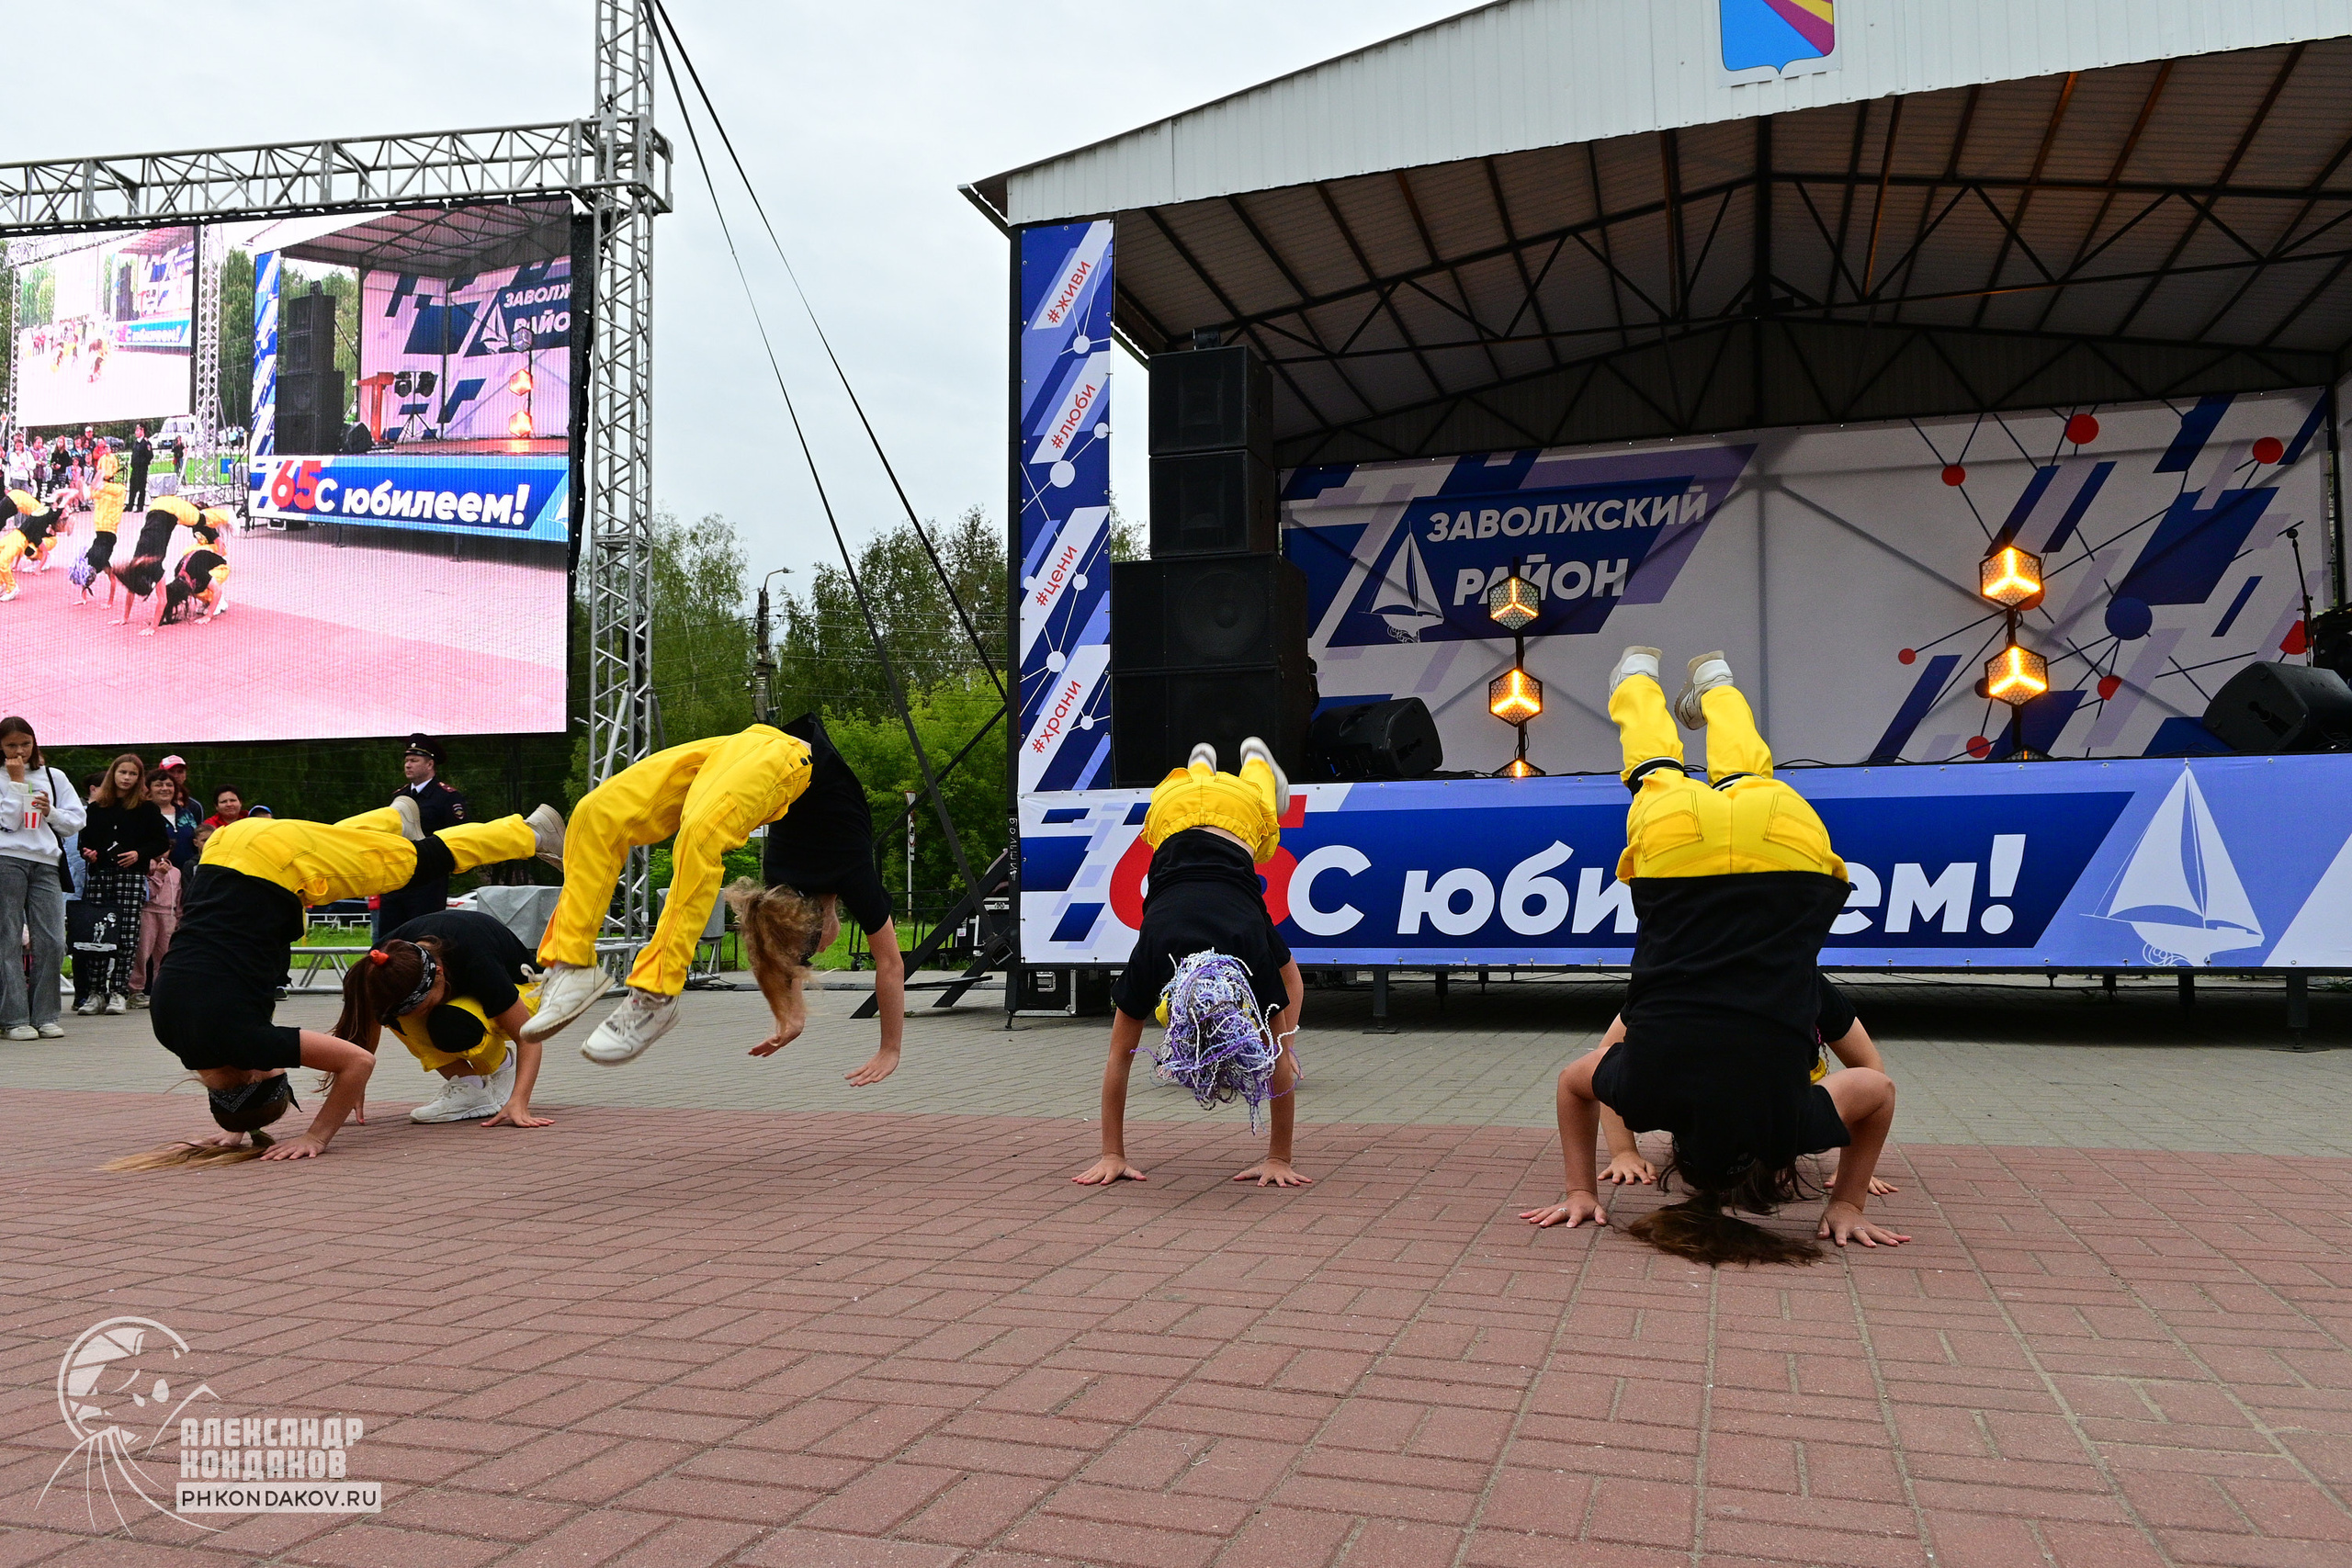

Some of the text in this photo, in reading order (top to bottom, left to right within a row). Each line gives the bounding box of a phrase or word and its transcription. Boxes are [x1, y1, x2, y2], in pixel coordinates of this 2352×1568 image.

[1046, 260, 1091, 323] #живи
[1051, 383, 1096, 449] #люби
[271, 460, 322, 510] 65
[342, 479, 530, 525] юбилеем!
[1426, 485, 1709, 543] ЗАВОЛЖСКИЙ
[1035, 545, 1079, 607] #цени
[1453, 553, 1629, 606] РАЙОН
[1031, 680, 1082, 754] #храни
[1396, 833, 2026, 936] юбием!
